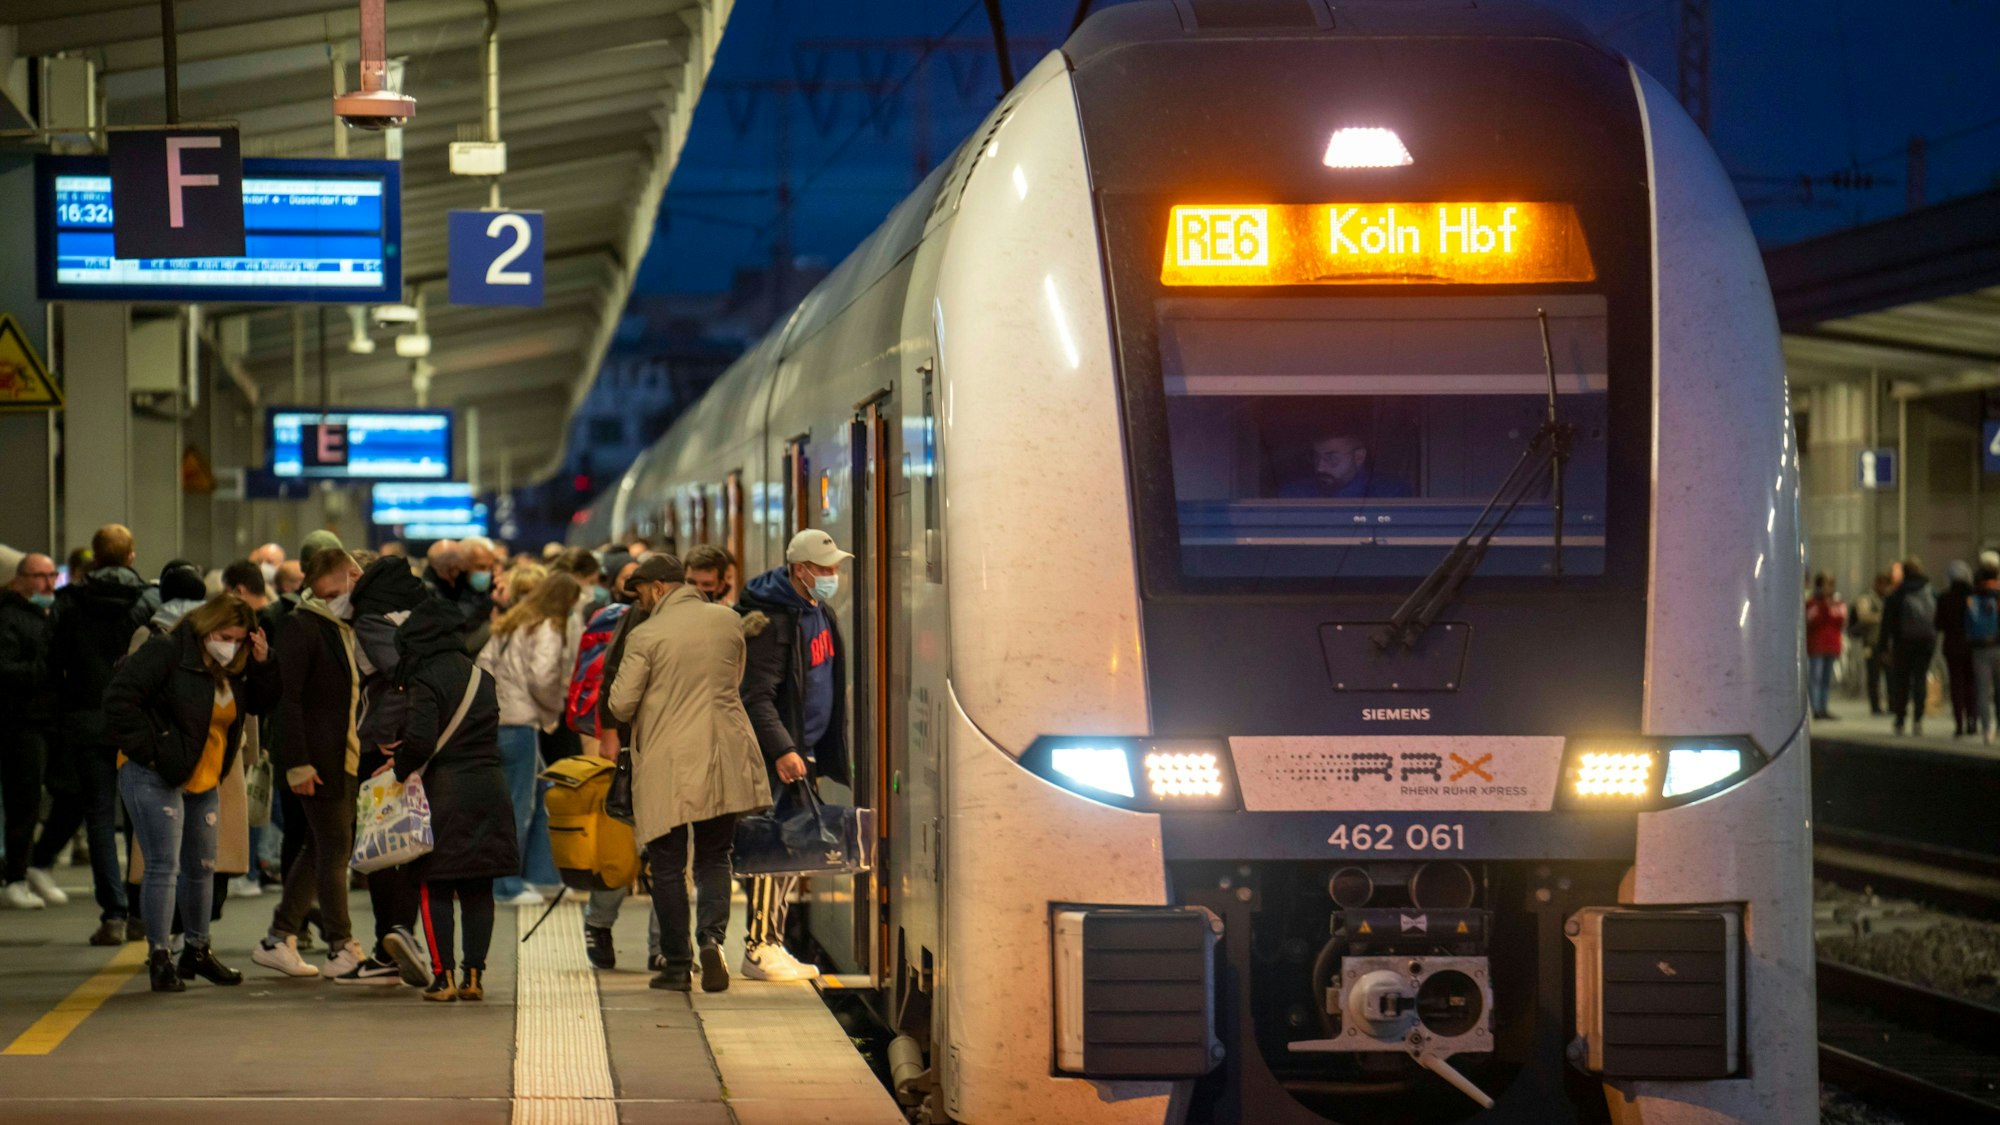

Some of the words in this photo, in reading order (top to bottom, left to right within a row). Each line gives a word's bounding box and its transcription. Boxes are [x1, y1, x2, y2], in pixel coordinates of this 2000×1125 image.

[166, 136, 221, 228] F
[486, 214, 532, 285] 2
[1182, 213, 1260, 260] RE6
[1329, 207, 1420, 254] Köln
[1439, 206, 1517, 254] Hbf
[317, 424, 344, 463] E
[1361, 708, 1431, 721] SIEMENS
[1351, 752, 1494, 783] RRX
[1400, 785, 1439, 796] RHEIN
[1442, 785, 1478, 796] RUHR
[1481, 785, 1528, 796] XPRESS
[1327, 823, 1394, 851] 462
[1405, 823, 1464, 851] 061
